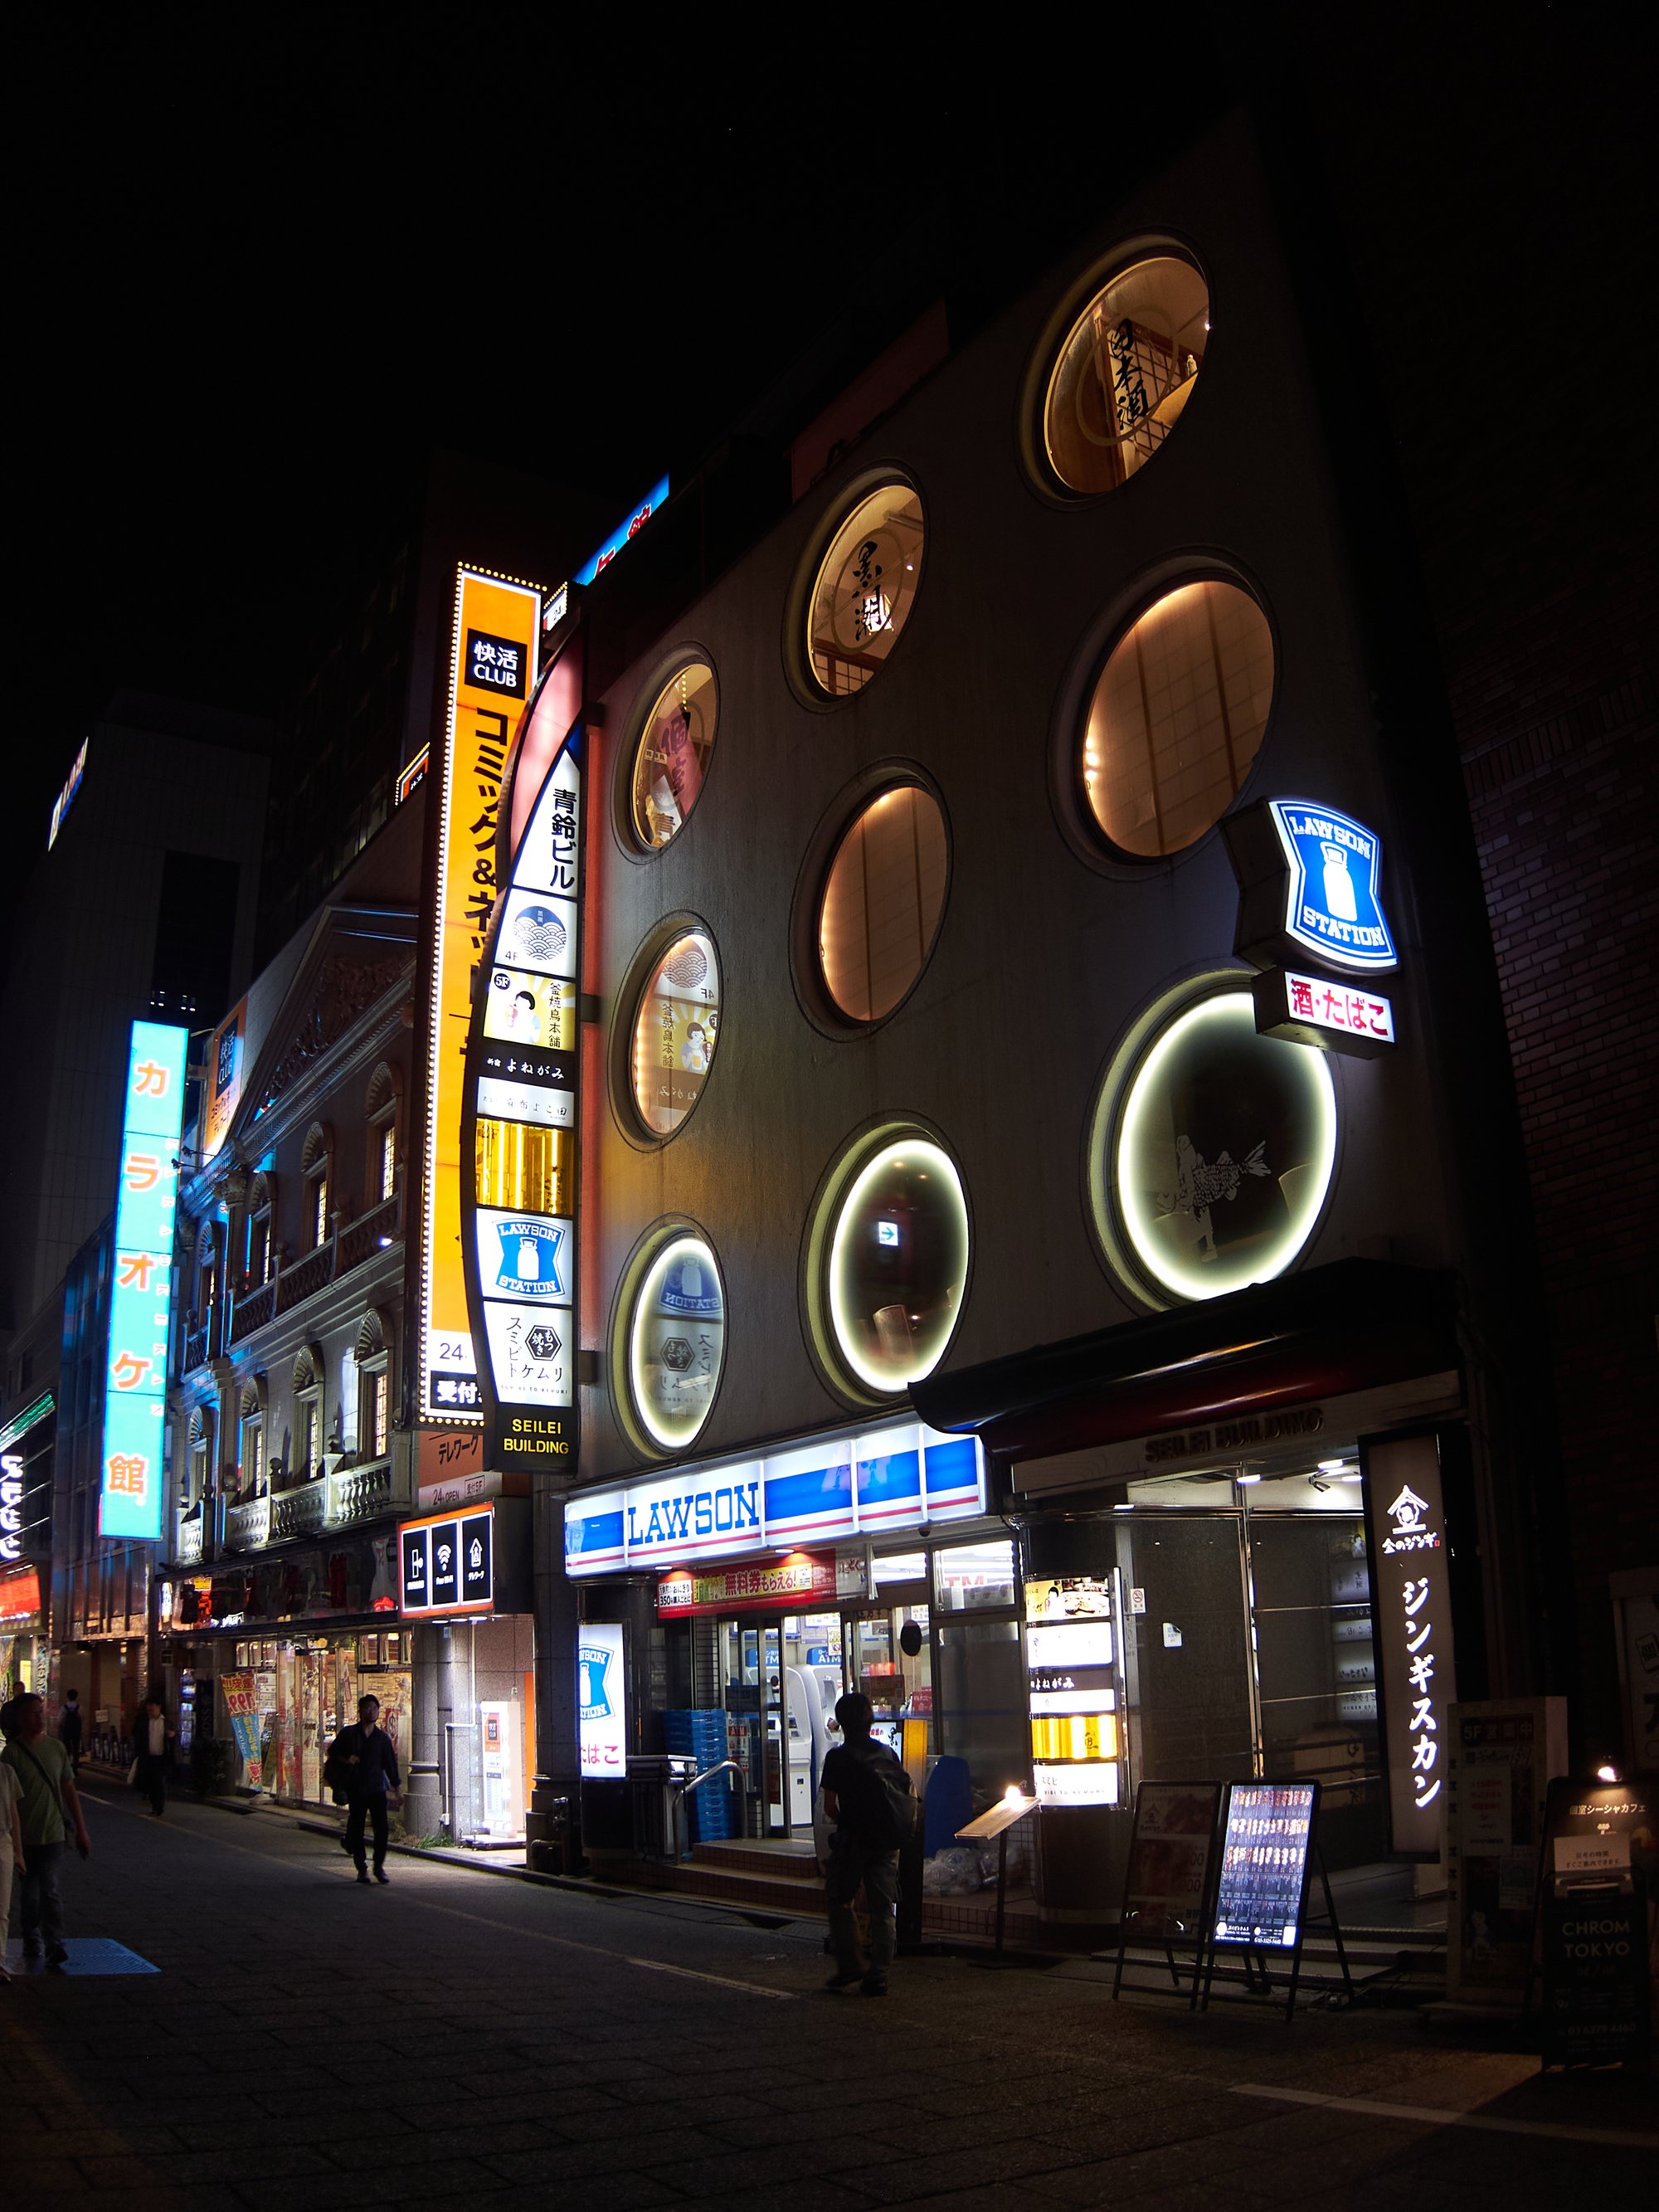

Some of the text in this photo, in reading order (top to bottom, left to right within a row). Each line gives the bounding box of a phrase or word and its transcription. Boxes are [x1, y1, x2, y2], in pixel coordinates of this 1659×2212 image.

[474, 641, 518, 670] 快活
[474, 664, 517, 688] CLUB
[550, 788, 577, 889] 青鈴ビル
[1289, 816, 1372, 860] LAWSON
[1303, 905, 1385, 947] STATION
[505, 951, 518, 961] 4F
[495, 976, 509, 987] 5F
[507, 1058, 565, 1079] よねがみ
[498, 1223, 558, 1243] LAWSON
[109, 1061, 168, 1494] カラオケ館
[498, 1274, 557, 1294] STATION
[436, 1380, 484, 1404] 受付
[512, 1418, 562, 1434] SEILEI
[504, 1438, 569, 1454] BUILDING
[628, 1481, 760, 1546] LAWSON
[1402, 1576, 1442, 1808] ジンギスカン
[1569, 1803, 1646, 1815] 個室シーシャカフェ
[1562, 1918, 1631, 1937] CHROM
[1564, 1941, 1630, 1959] TOKYO
